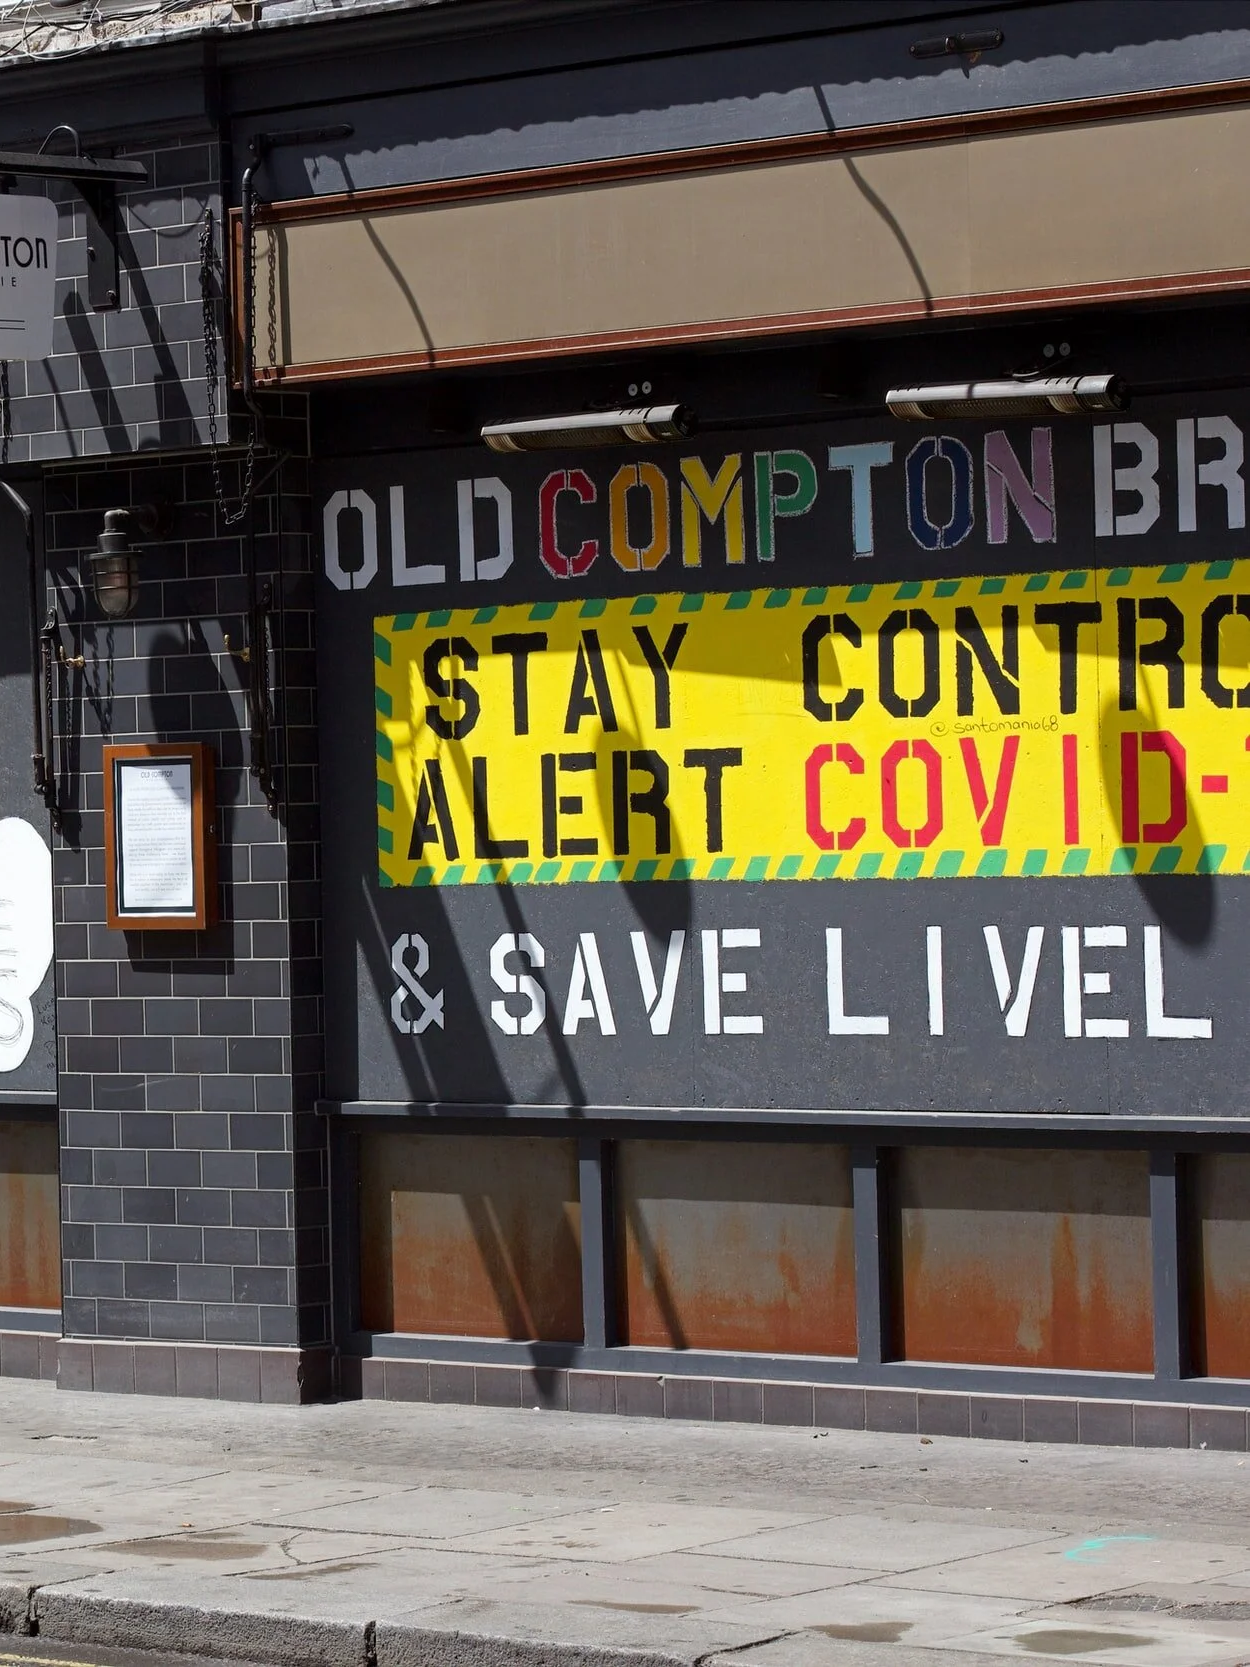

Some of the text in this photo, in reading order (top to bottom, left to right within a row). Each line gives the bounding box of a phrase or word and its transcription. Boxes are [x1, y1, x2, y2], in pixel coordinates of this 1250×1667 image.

[323, 415, 1246, 590] OLD COMPTON BR
[423, 622, 688, 740] STAY
[803, 596, 1250, 722] CONTRO
[407, 748, 743, 862] ALERT
[805, 731, 1250, 850] COVID-
[391, 932, 445, 1034] &
[491, 930, 763, 1036] SAVE
